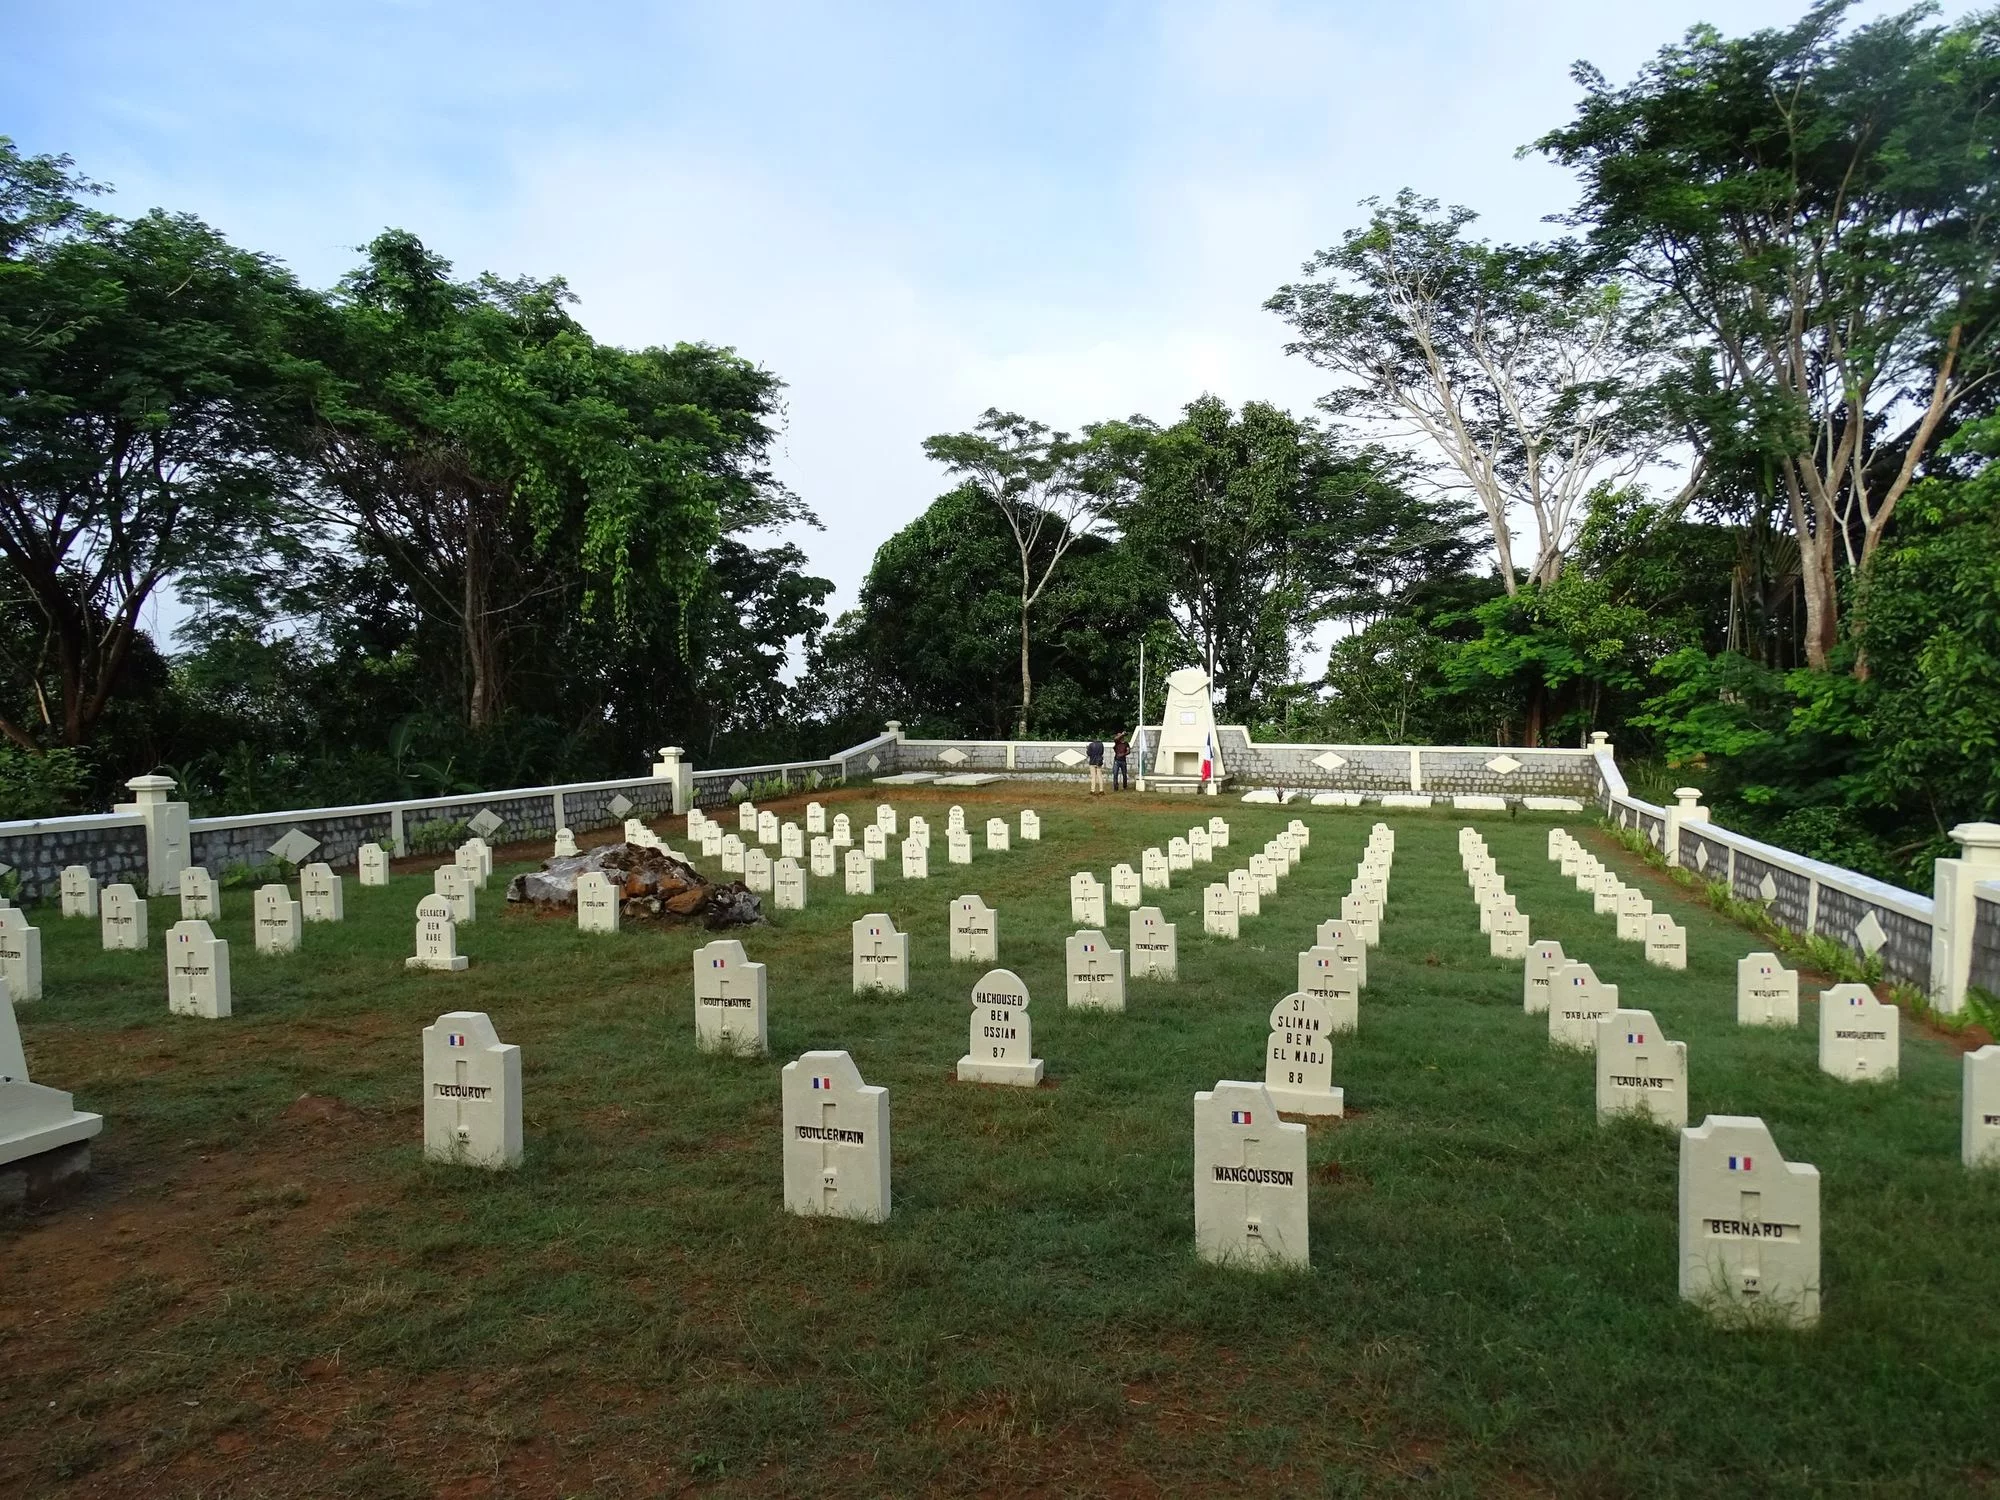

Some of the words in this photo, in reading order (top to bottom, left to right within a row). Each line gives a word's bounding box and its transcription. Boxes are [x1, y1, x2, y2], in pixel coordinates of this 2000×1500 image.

[427, 922, 439, 930] BEN
[429, 946, 438, 954] 75
[976, 992, 1023, 1006] HACHOUSED
[1314, 990, 1339, 998] PERON
[1293, 999, 1305, 1012] SI
[990, 1010, 1009, 1022] BEN
[1277, 1015, 1319, 1031] SLIMAN
[1286, 1032, 1312, 1046] BEN
[992, 1047, 1006, 1058] 87
[1273, 1048, 1287, 1060] EL
[1288, 1071, 1303, 1084] 88
[1617, 1077, 1663, 1088] LAURANS
[440, 1086, 486, 1099] LELOUROY
[799, 1127, 864, 1144] GUILLERMAIN
[1215, 1168, 1294, 1186] MANGOUSSON
[1712, 1220, 1783, 1238] BERNARD
